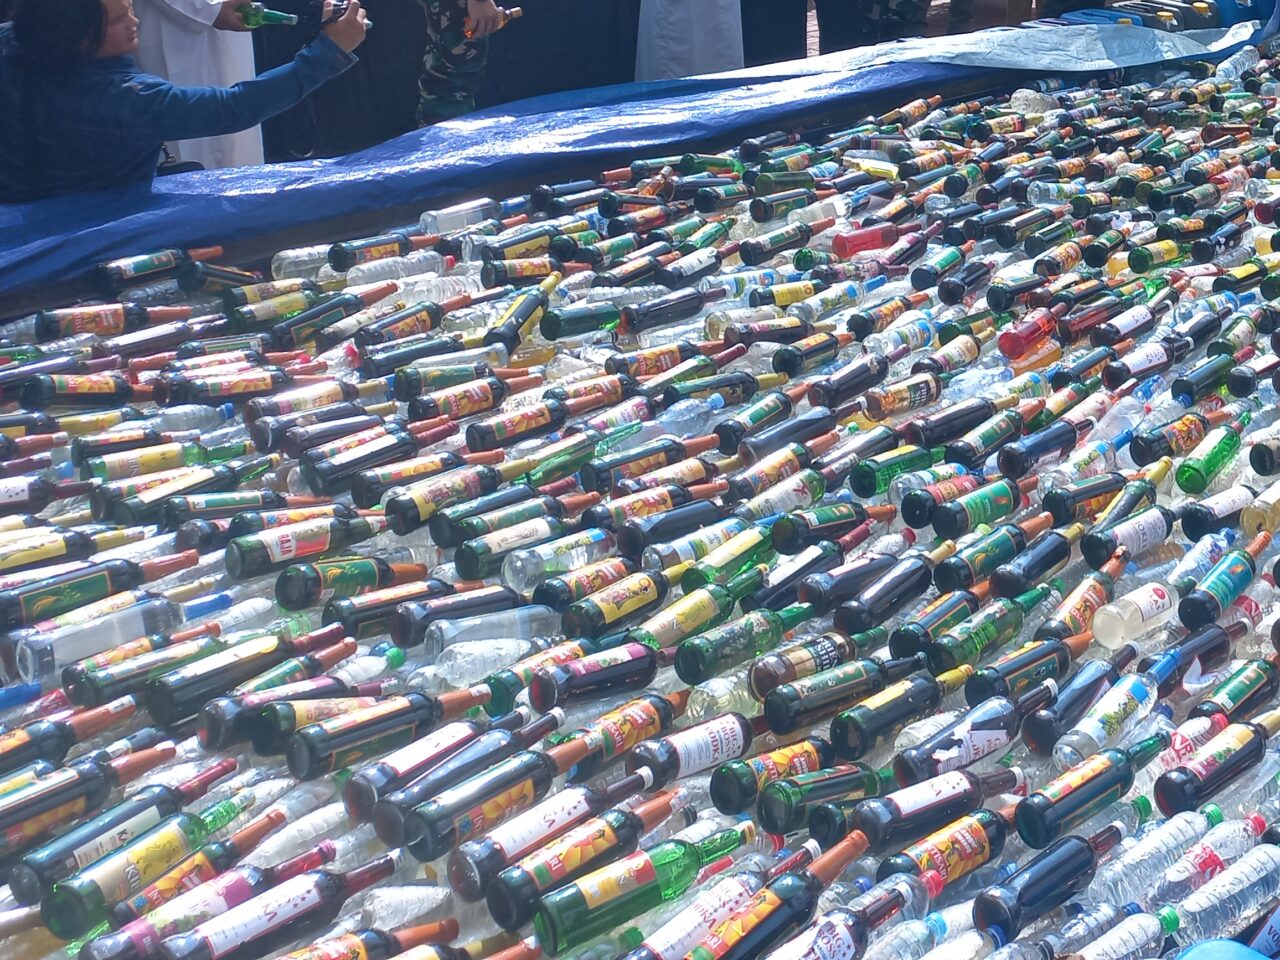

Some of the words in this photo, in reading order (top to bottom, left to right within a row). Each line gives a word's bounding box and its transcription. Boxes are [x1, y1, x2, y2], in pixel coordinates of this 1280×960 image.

[816, 637, 838, 668] FRIEN
[705, 725, 721, 764] VODKA
[720, 725, 734, 754] BOSS
[728, 726, 739, 749] BIG
[826, 926, 845, 949] BIG
